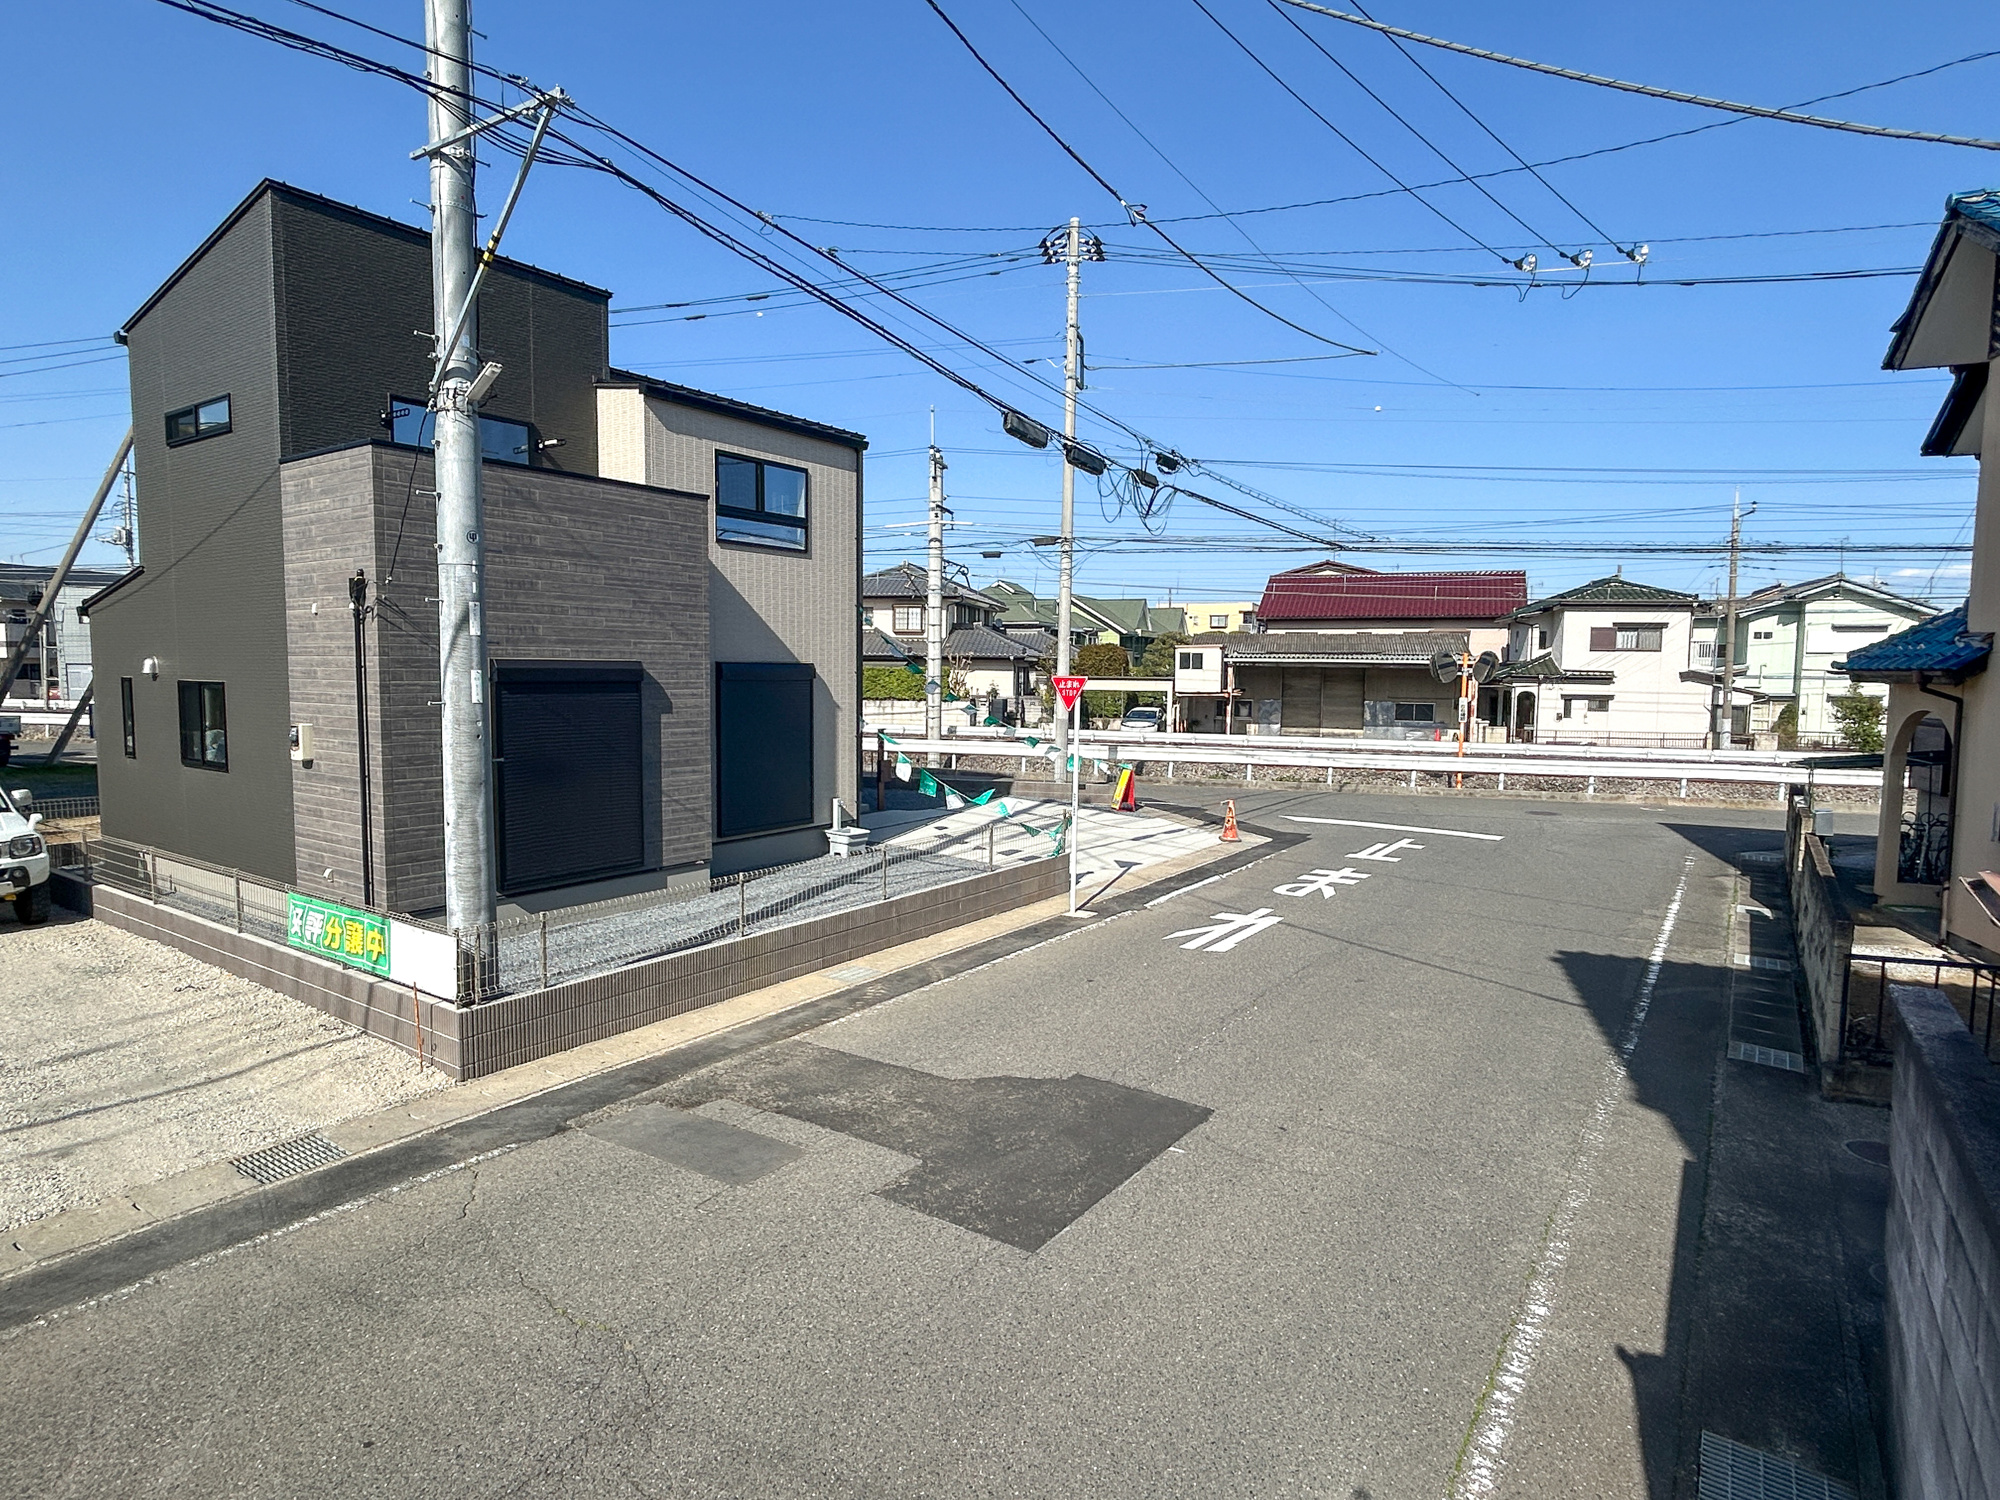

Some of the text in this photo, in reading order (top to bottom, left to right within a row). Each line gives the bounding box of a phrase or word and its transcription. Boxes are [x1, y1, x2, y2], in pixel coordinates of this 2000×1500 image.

[1058, 680, 1080, 688] 止まれ
[1061, 689, 1077, 697] STOP
[1162, 838, 1427, 952] 止まれ
[291, 905, 385, 961] 好評分譲中
